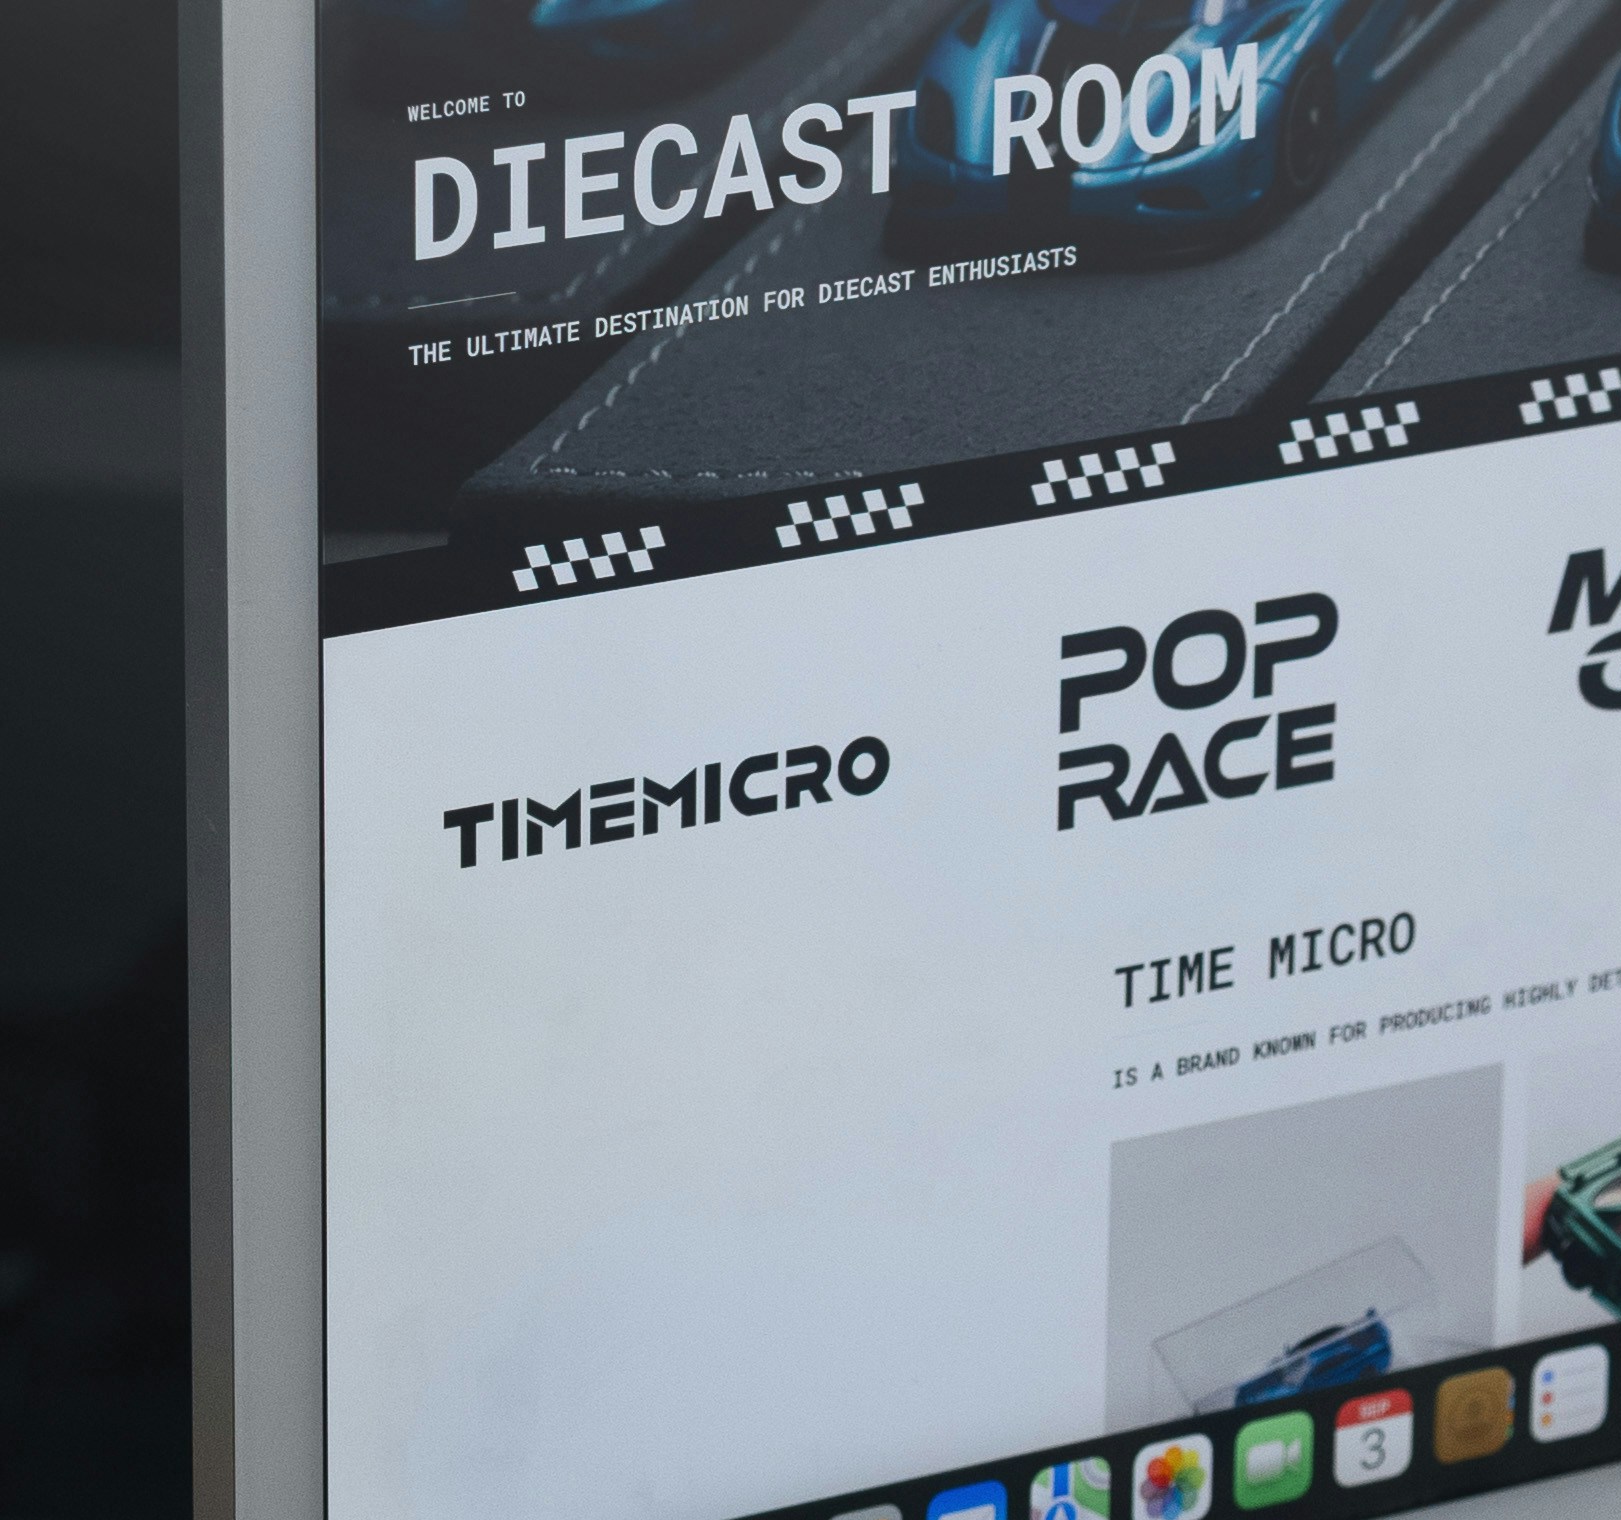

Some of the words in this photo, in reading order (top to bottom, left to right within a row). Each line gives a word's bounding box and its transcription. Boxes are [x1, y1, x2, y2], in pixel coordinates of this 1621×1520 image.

[407, 95, 490, 122] WELCOME
[502, 90, 526, 109] TO
[415, 91, 916, 261] DIECAST
[993, 42, 1258, 176] ROOM
[408, 340, 452, 366] THE
[467, 320, 580, 357] ULTIMATE
[595, 295, 749, 338] DESTINATION
[763, 287, 805, 312] FOR
[818, 269, 915, 304] DIECAST
[928, 245, 1077, 287] ENTHUSIASTS
[1058, 591, 1340, 734] POP
[443, 735, 891, 869] TIMEMICRO
[1057, 702, 1337, 832] RACE
[1114, 945, 1235, 1008] TIME
[1268, 911, 1417, 980] MICRO
[1113, 1067, 1138, 1090] IS
[1151, 1062, 1164, 1082] A
[1176, 1046, 1241, 1077] BRAND
[1252, 1030, 1317, 1061] KNOWN
[1328, 1020, 1367, 1045] FOR
[1379, 995, 1492, 1034] PRODUCING
[1502, 978, 1579, 1010] HIGHLY
[1361, 1428, 1387, 1470] 3
